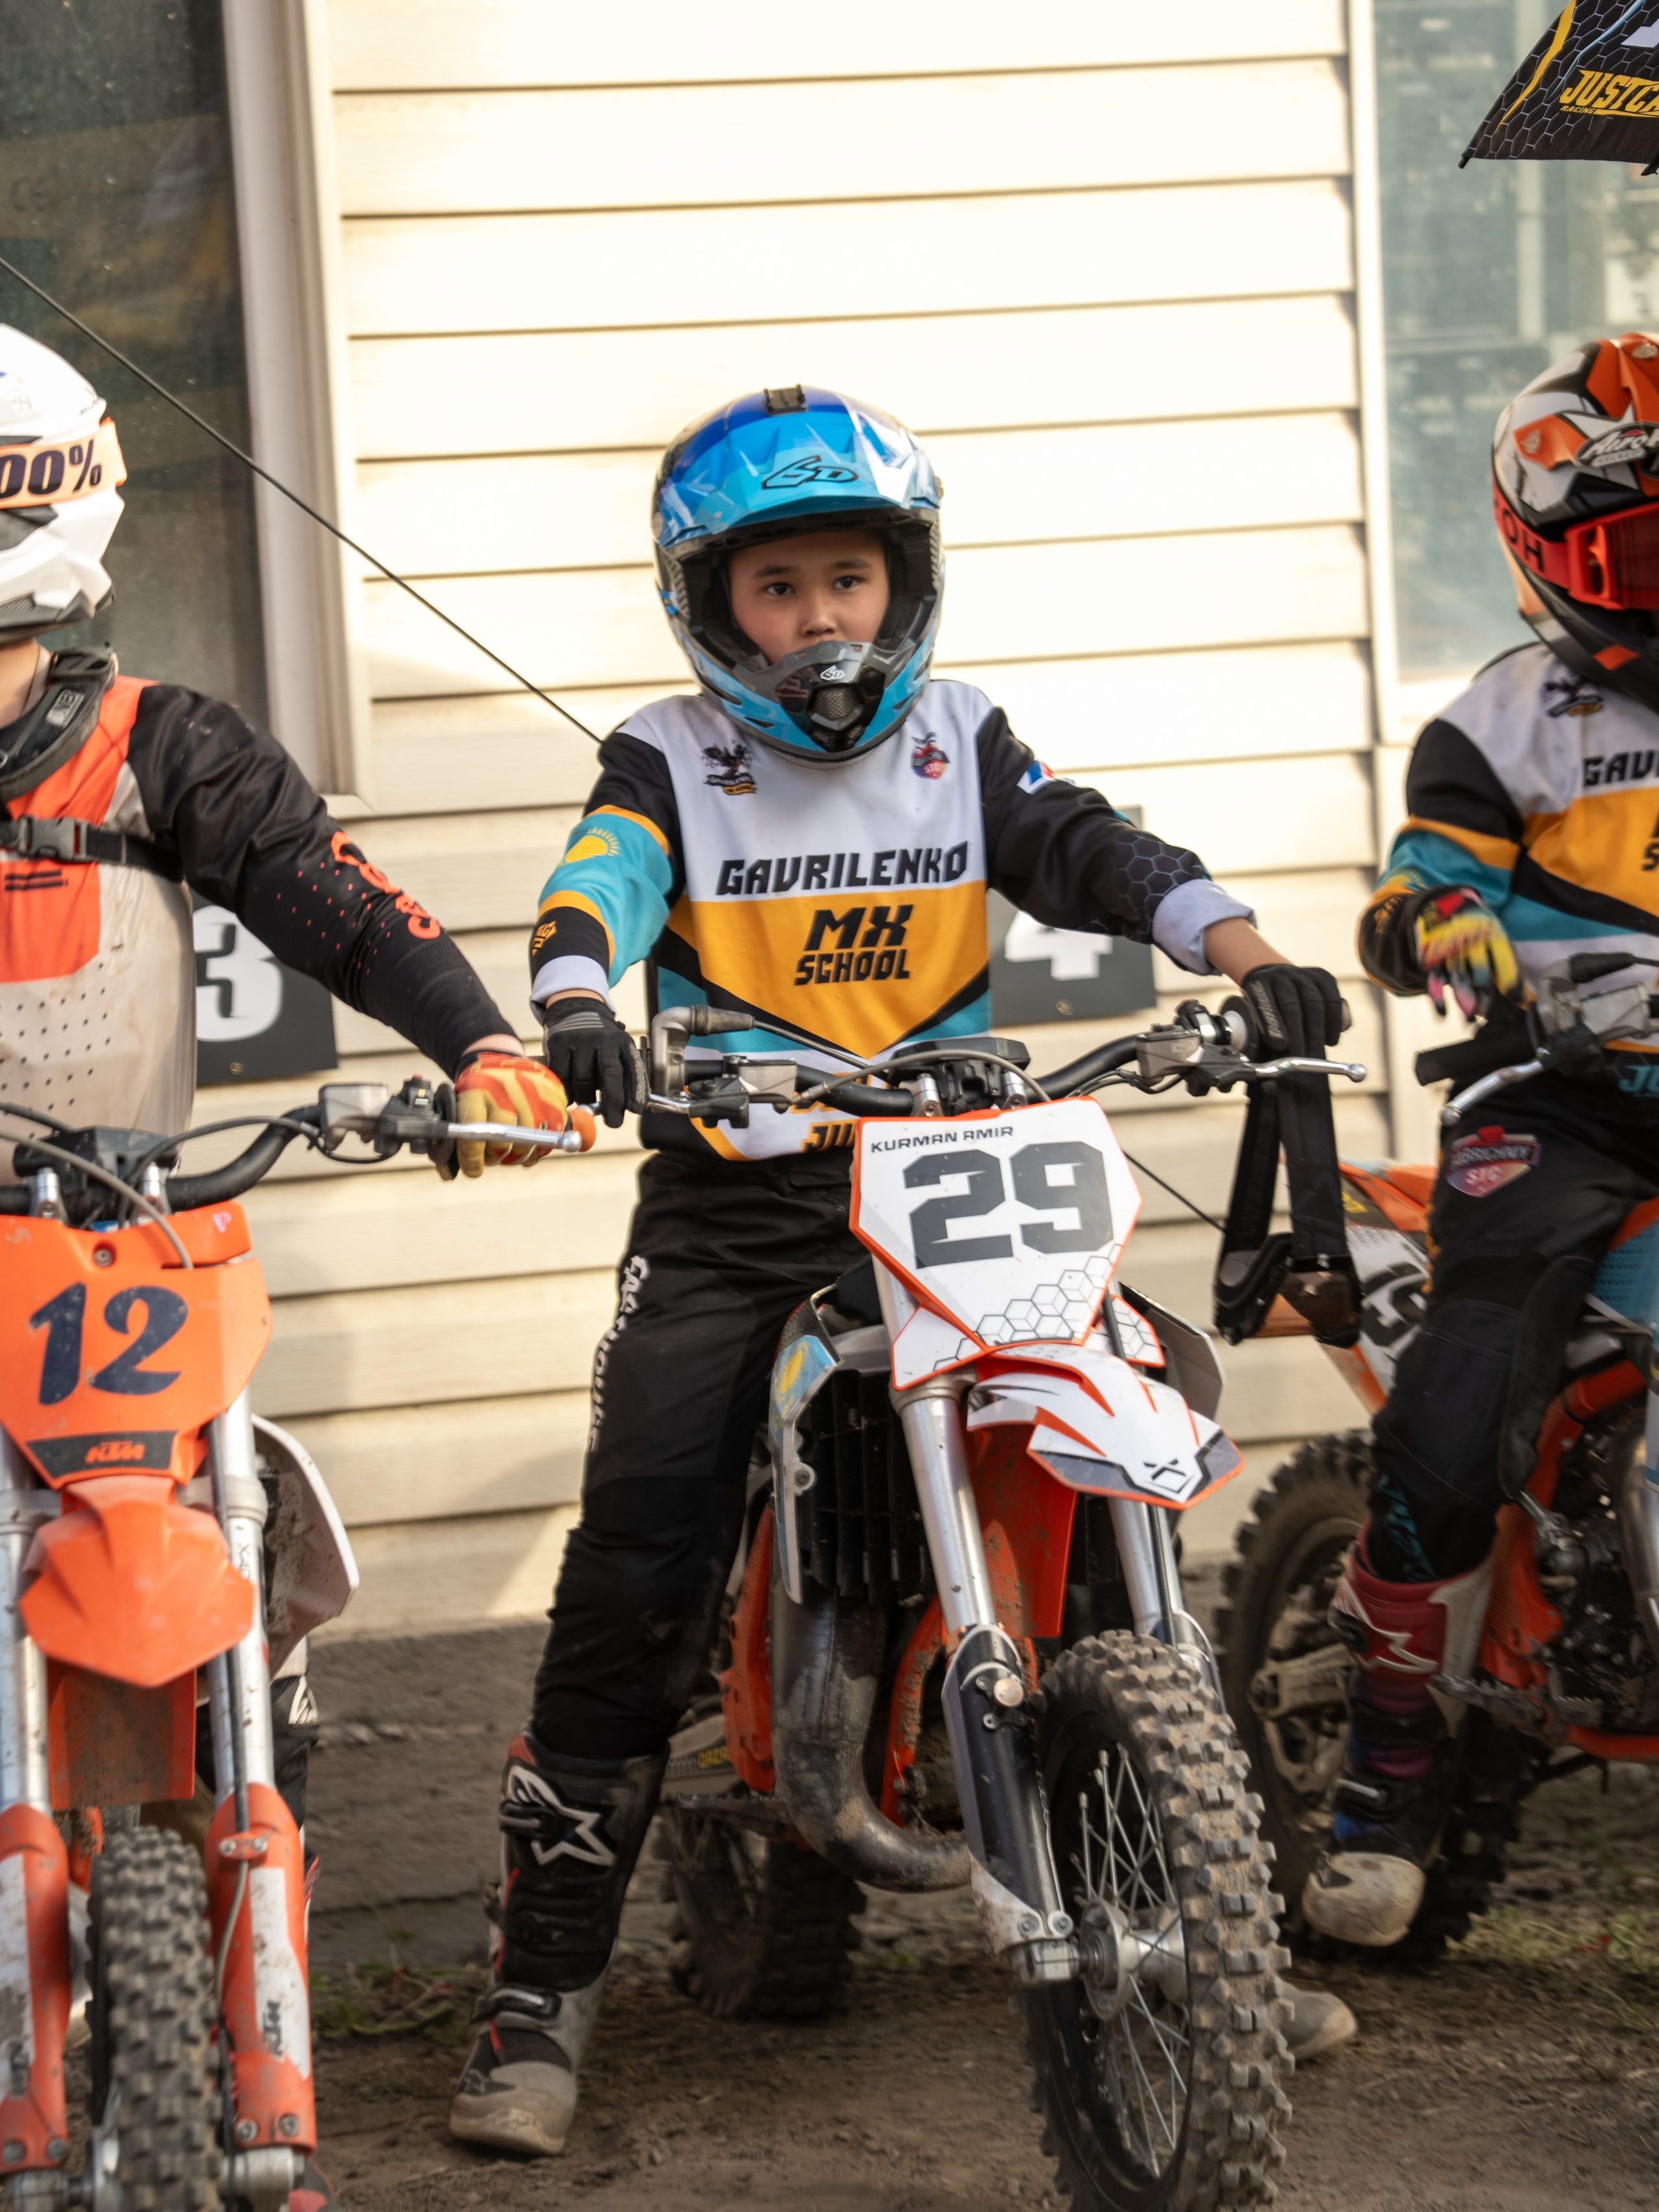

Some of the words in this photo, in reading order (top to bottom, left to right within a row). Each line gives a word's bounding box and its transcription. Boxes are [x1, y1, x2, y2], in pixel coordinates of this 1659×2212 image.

[1559, 106, 1596, 114] RACING
[1583, 749, 1659, 787] GAV
[715, 841, 968, 895] GAVRILENKO
[804, 904, 914, 951] MX
[794, 949, 910, 986] SCHOOL
[871, 1132, 957, 1153] KURMAN
[963, 1126, 1014, 1141] AMIR
[902, 1141, 1114, 1270] 29
[30, 1281, 189, 1405] 12
[85, 1440, 145, 1464] KTM
